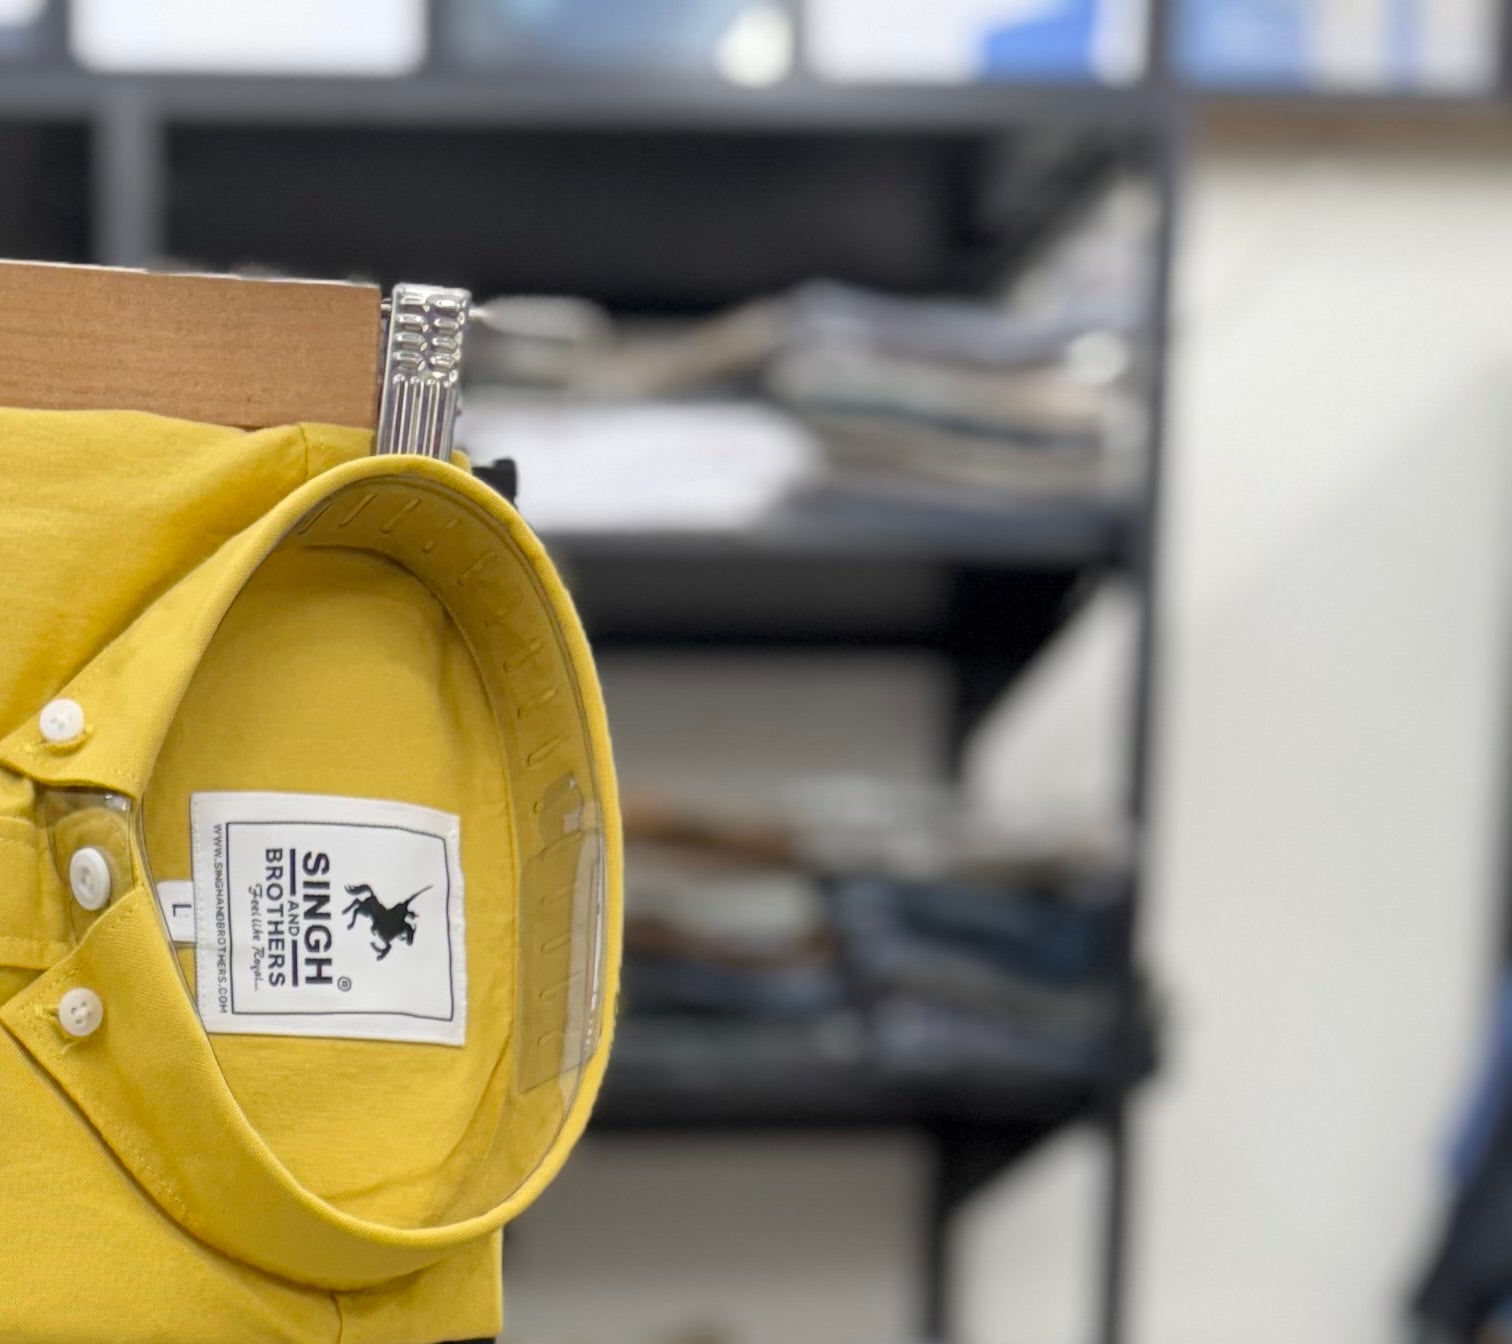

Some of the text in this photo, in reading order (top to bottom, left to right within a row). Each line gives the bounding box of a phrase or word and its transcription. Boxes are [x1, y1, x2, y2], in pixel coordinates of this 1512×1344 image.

[172, 903, 192, 917] L
[213, 824, 228, 1014] WWW.SINGHANDBROTHERS.COM
[248, 883, 263, 916] Feel
[265, 848, 286, 988] BROTHERS
[287, 900, 301, 937] AND
[302, 851, 334, 986] SINGH
